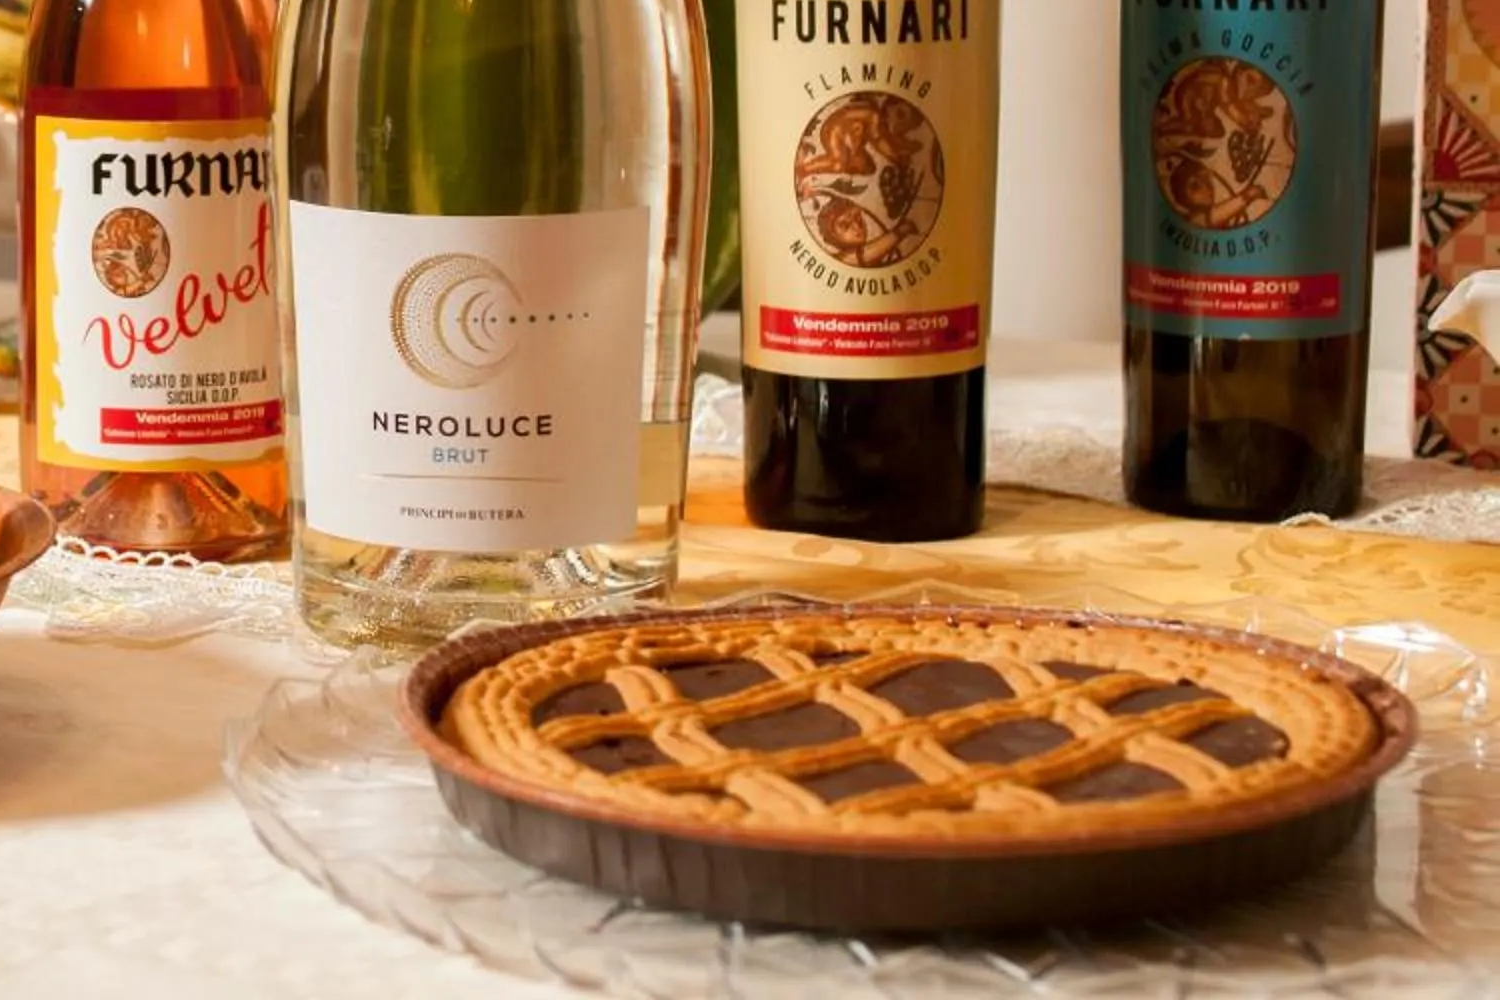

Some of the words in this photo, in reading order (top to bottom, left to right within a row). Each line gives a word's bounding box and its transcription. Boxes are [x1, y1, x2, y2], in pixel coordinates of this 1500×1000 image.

[789, 239, 827, 281] NERO
[82, 200, 271, 370] Velvet
[1149, 271, 1247, 294] Vendemmia
[1252, 280, 1301, 295] 2019
[793, 314, 901, 333] Vendemmia
[905, 315, 949, 332] 2019
[130, 372, 177, 389] ROSATO
[180, 373, 193, 388] DI
[196, 372, 227, 387] NERO
[167, 390, 207, 405] SICILIA
[135, 410, 229, 425] Vendemmia
[233, 407, 266, 420] 2019
[372, 411, 554, 438] NEROLUCE
[431, 447, 490, 465] BRUT
[468, 508, 525, 521] BUTERA
